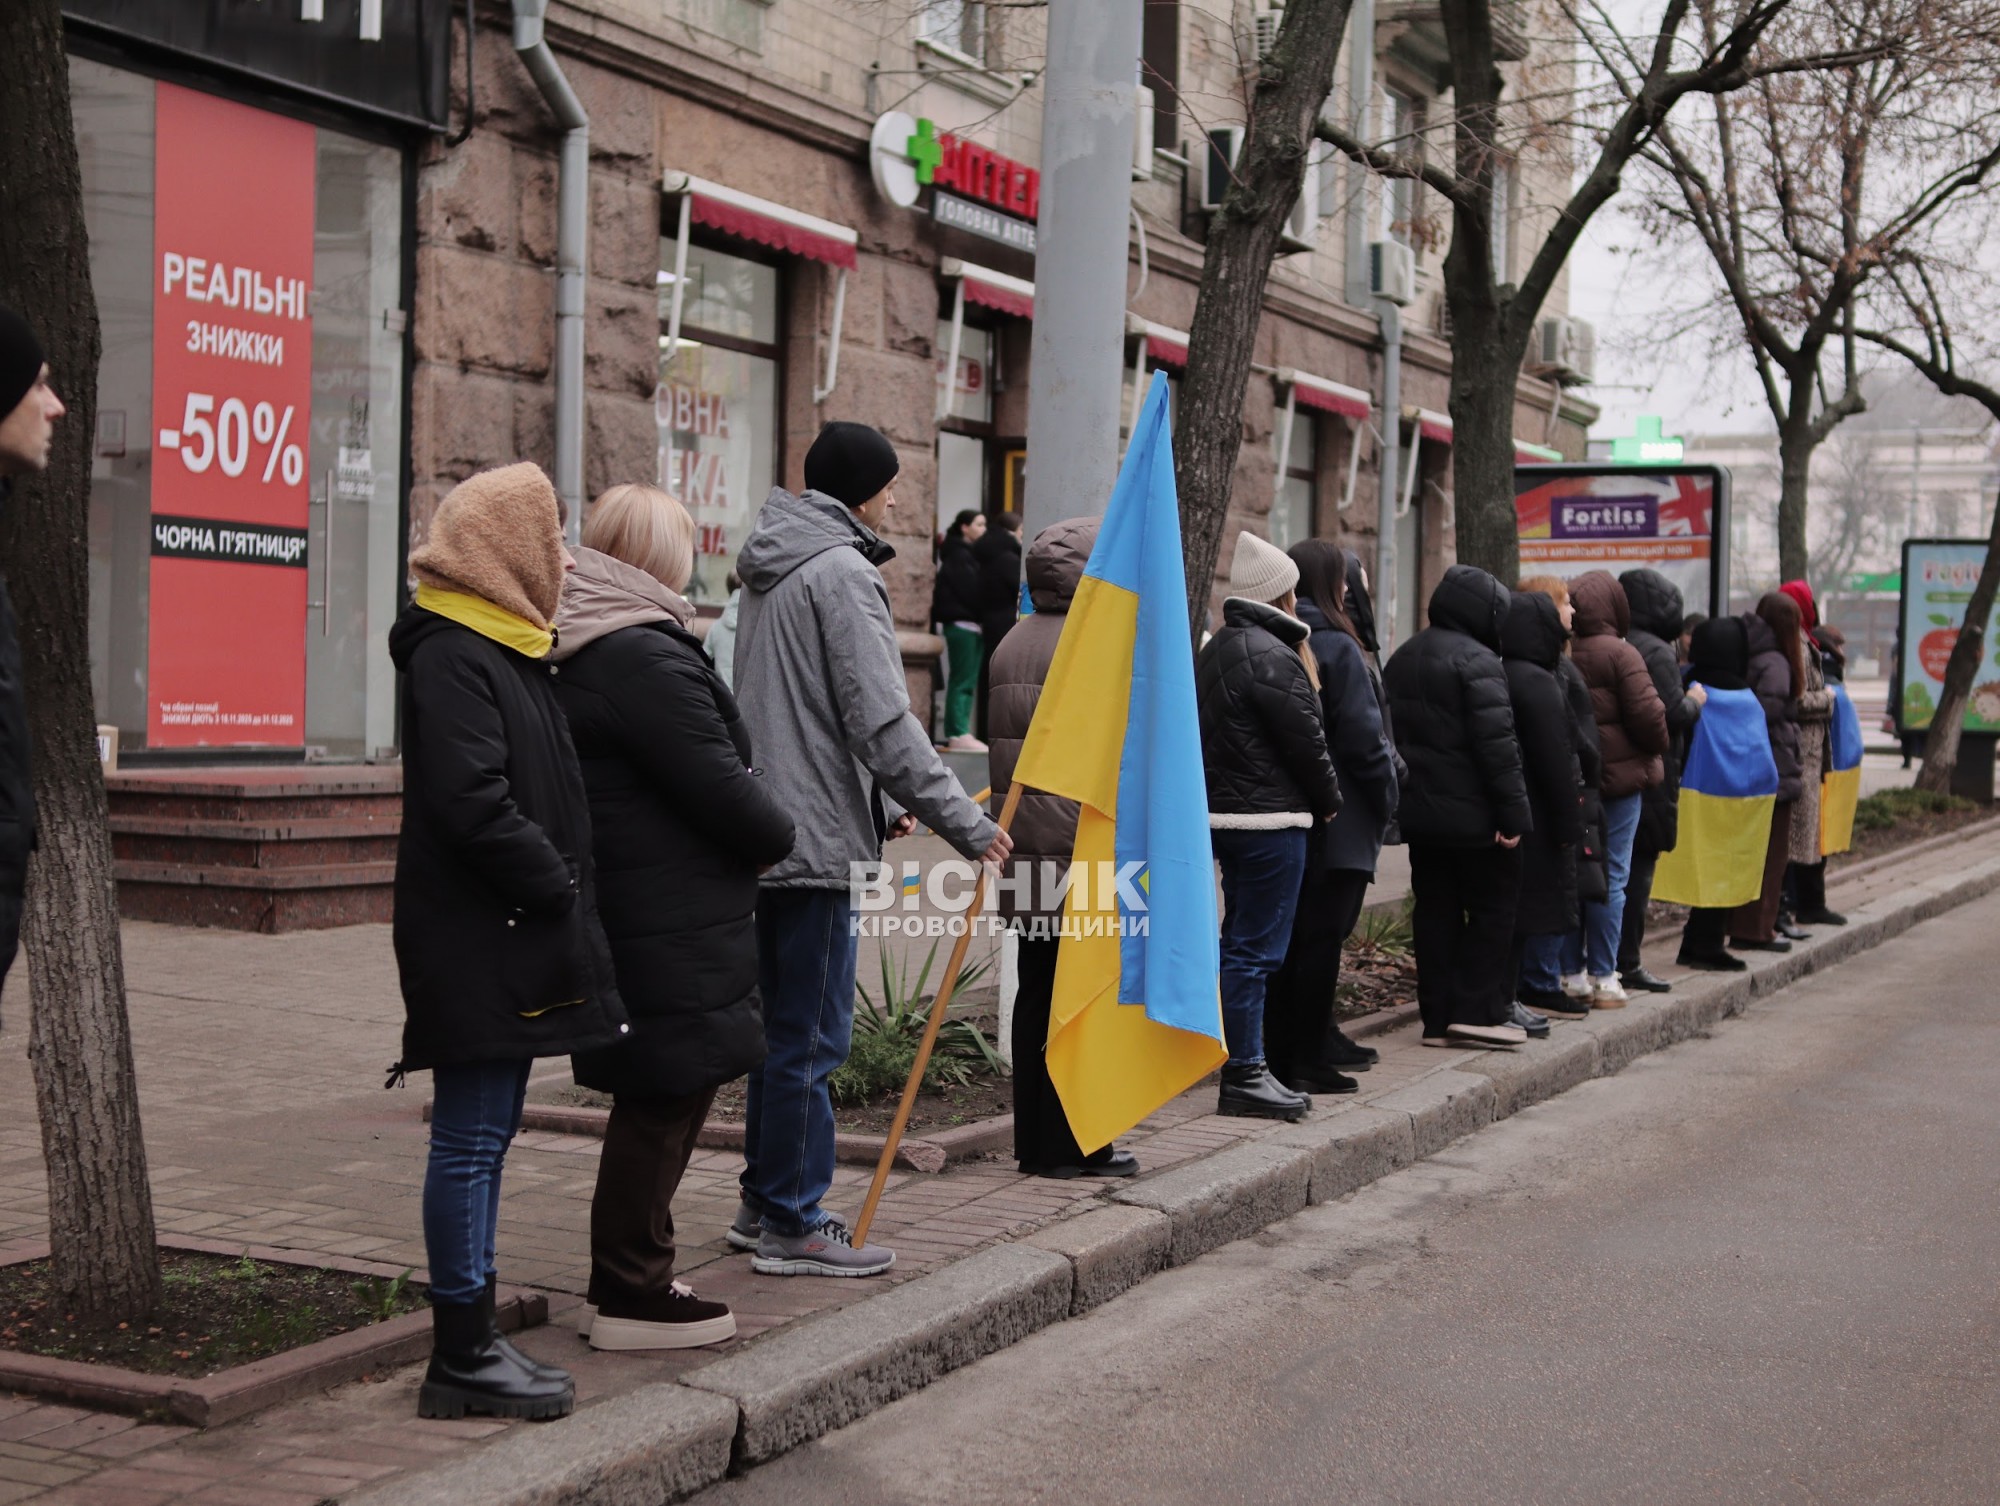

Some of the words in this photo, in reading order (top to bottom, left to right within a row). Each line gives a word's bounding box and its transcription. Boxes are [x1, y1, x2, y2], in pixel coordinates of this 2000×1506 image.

[935, 197, 1000, 236] ГОЛОВНА
[163, 251, 305, 320] РЕАЛЬНІ
[186, 320, 283, 366] ЗНИЖКИ
[159, 391, 304, 487] -50%
[1561, 506, 1647, 526] Fortiss
[155, 523, 216, 553] ЧОРНА
